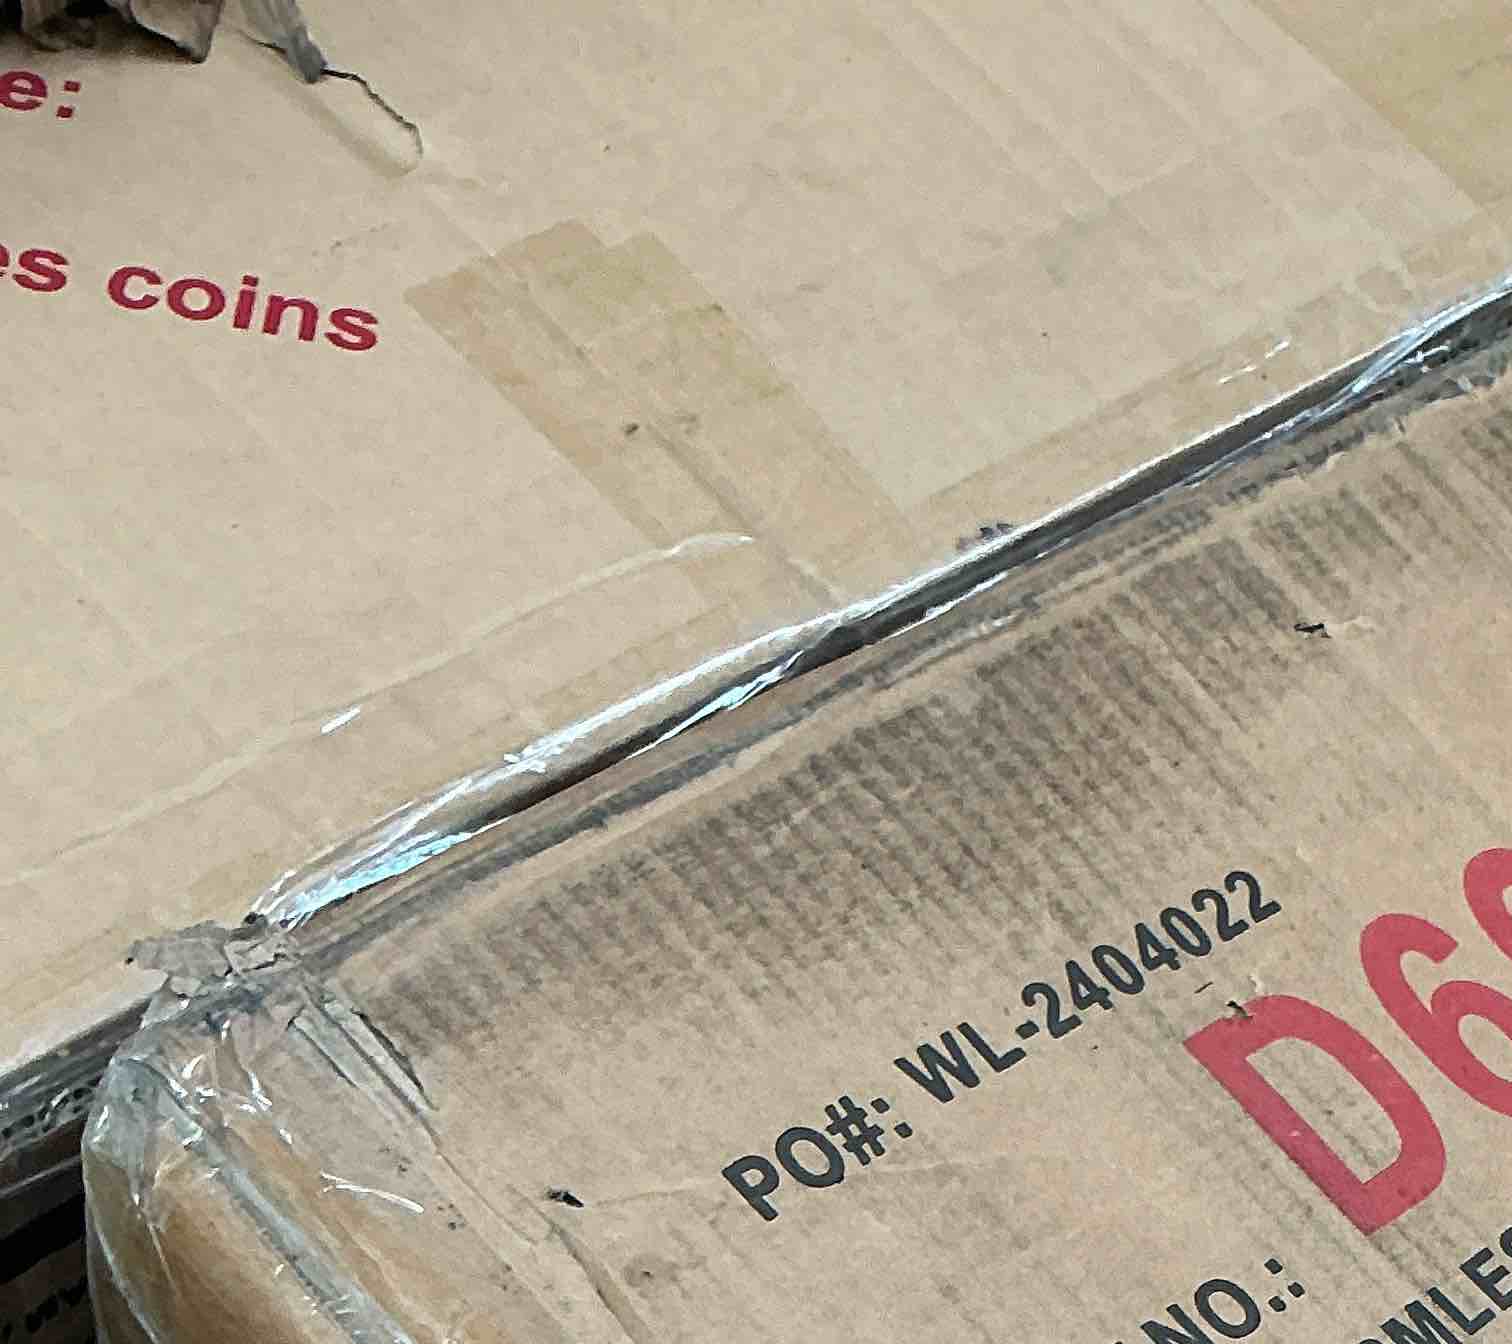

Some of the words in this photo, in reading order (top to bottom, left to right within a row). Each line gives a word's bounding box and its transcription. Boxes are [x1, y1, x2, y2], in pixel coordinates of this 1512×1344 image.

[0, 245, 69, 291] s
[107, 265, 379, 351] coins
[721, 1095, 912, 1222] PO#:
[894, 871, 1281, 1104] WL-2404022
